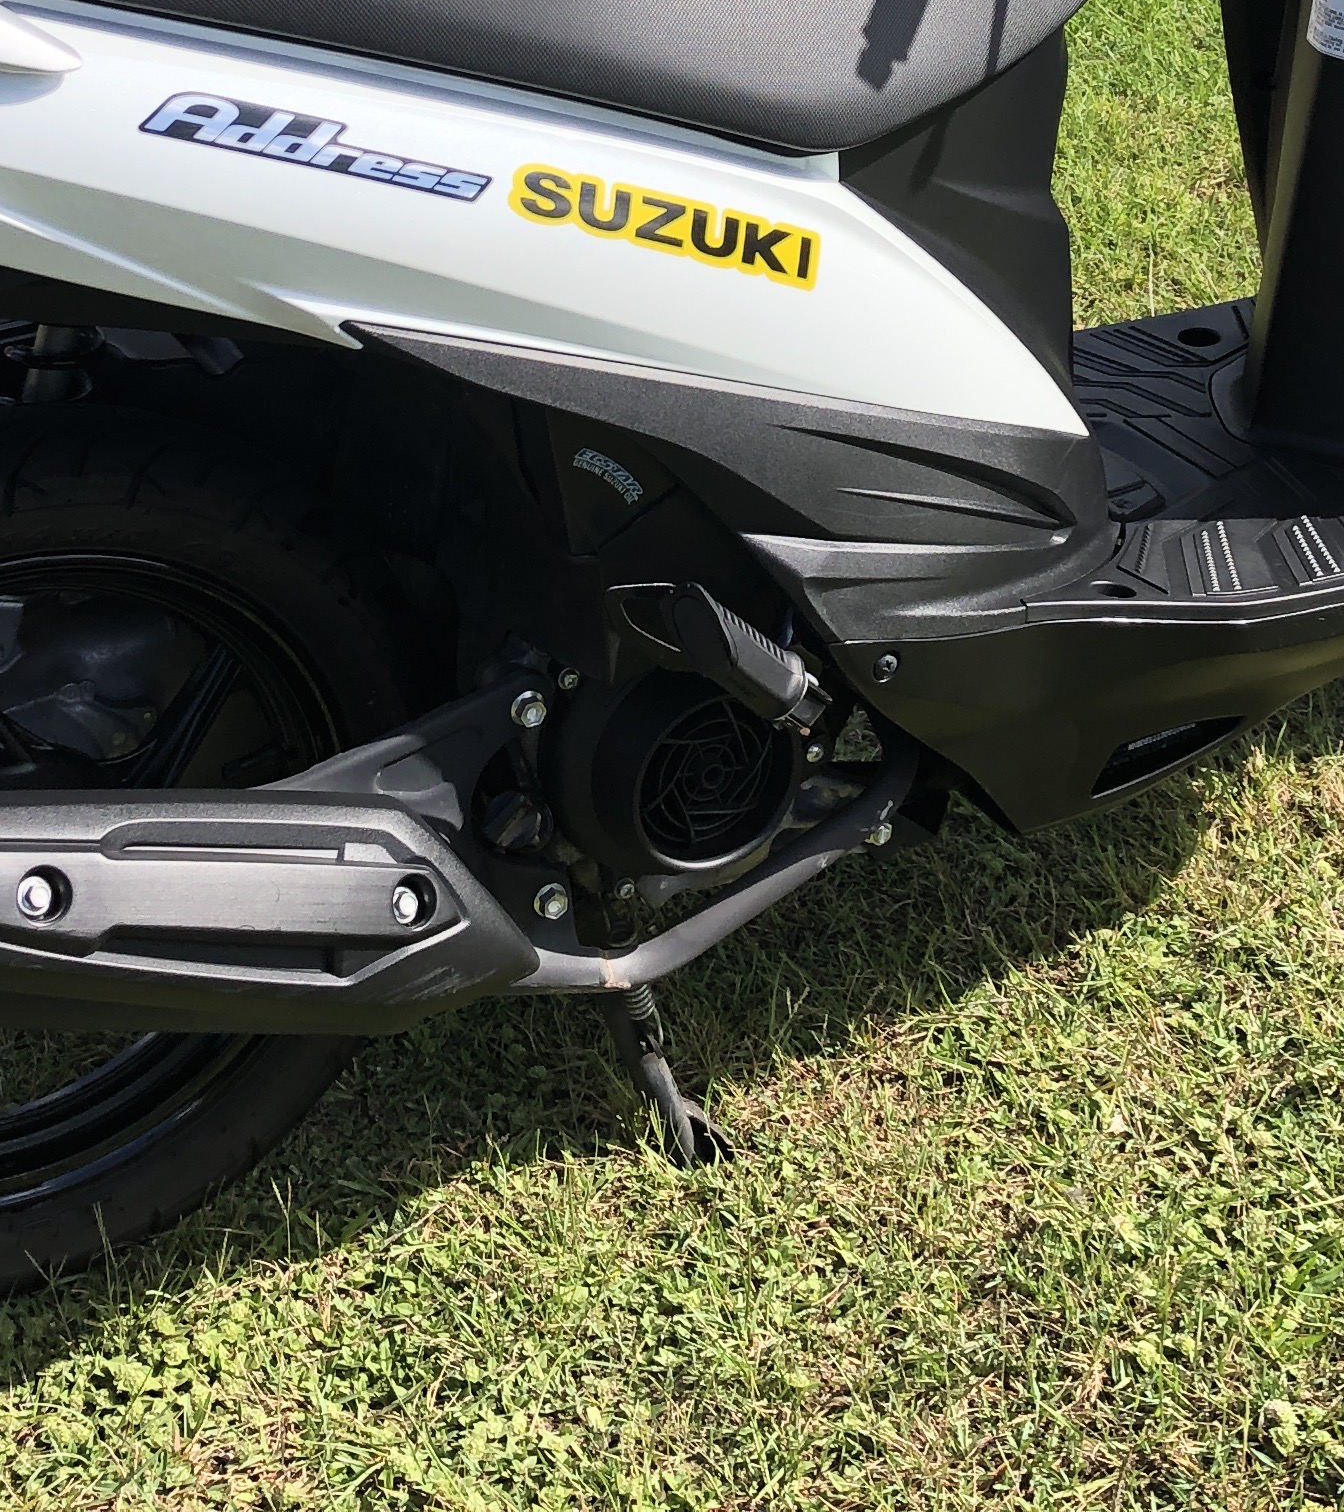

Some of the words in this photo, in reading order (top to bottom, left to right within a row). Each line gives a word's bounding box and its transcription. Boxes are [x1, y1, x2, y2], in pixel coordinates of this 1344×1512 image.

[144, 94, 488, 201] Address
[518, 169, 811, 281] SUZUKI
[602, 472, 627, 495] SUZUKI
